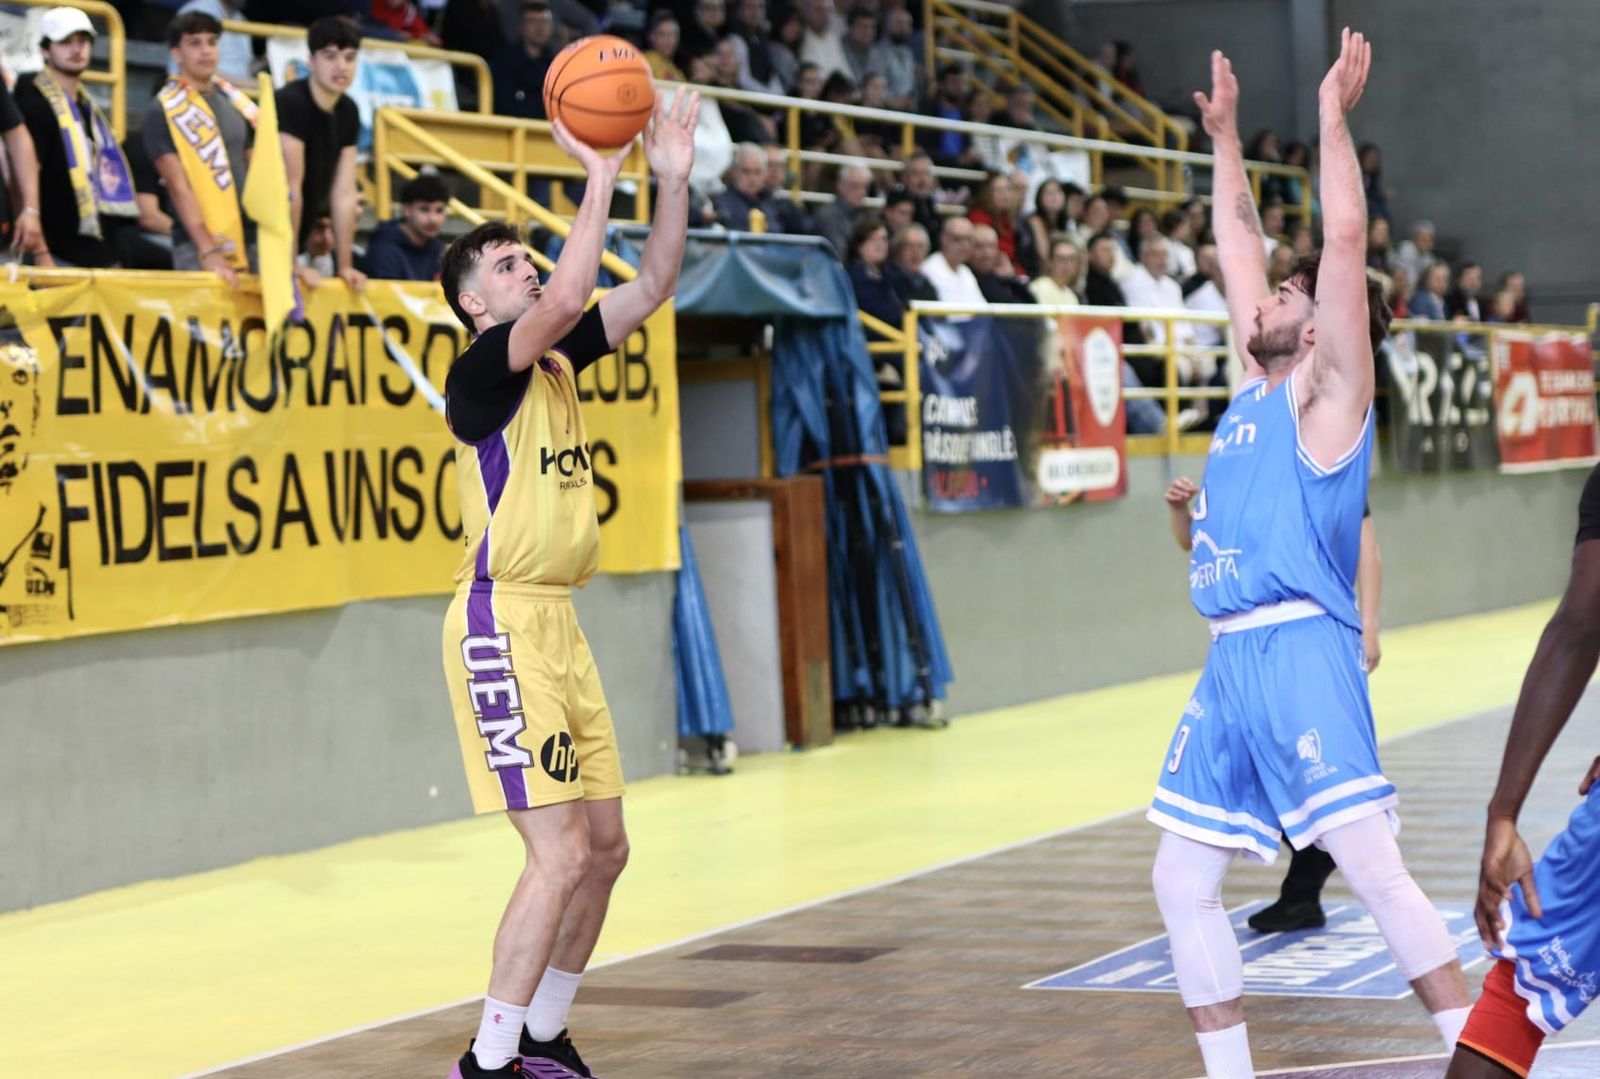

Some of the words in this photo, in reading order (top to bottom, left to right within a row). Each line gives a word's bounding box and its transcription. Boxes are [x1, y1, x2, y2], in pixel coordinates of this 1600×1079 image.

[46, 312, 416, 415] ENAMORATS
[55, 456, 262, 570] FIDELS
[272, 452, 320, 550] A
[324, 446, 426, 544] UNS
[460, 632, 535, 772] UEM
[545, 732, 580, 782] hp
